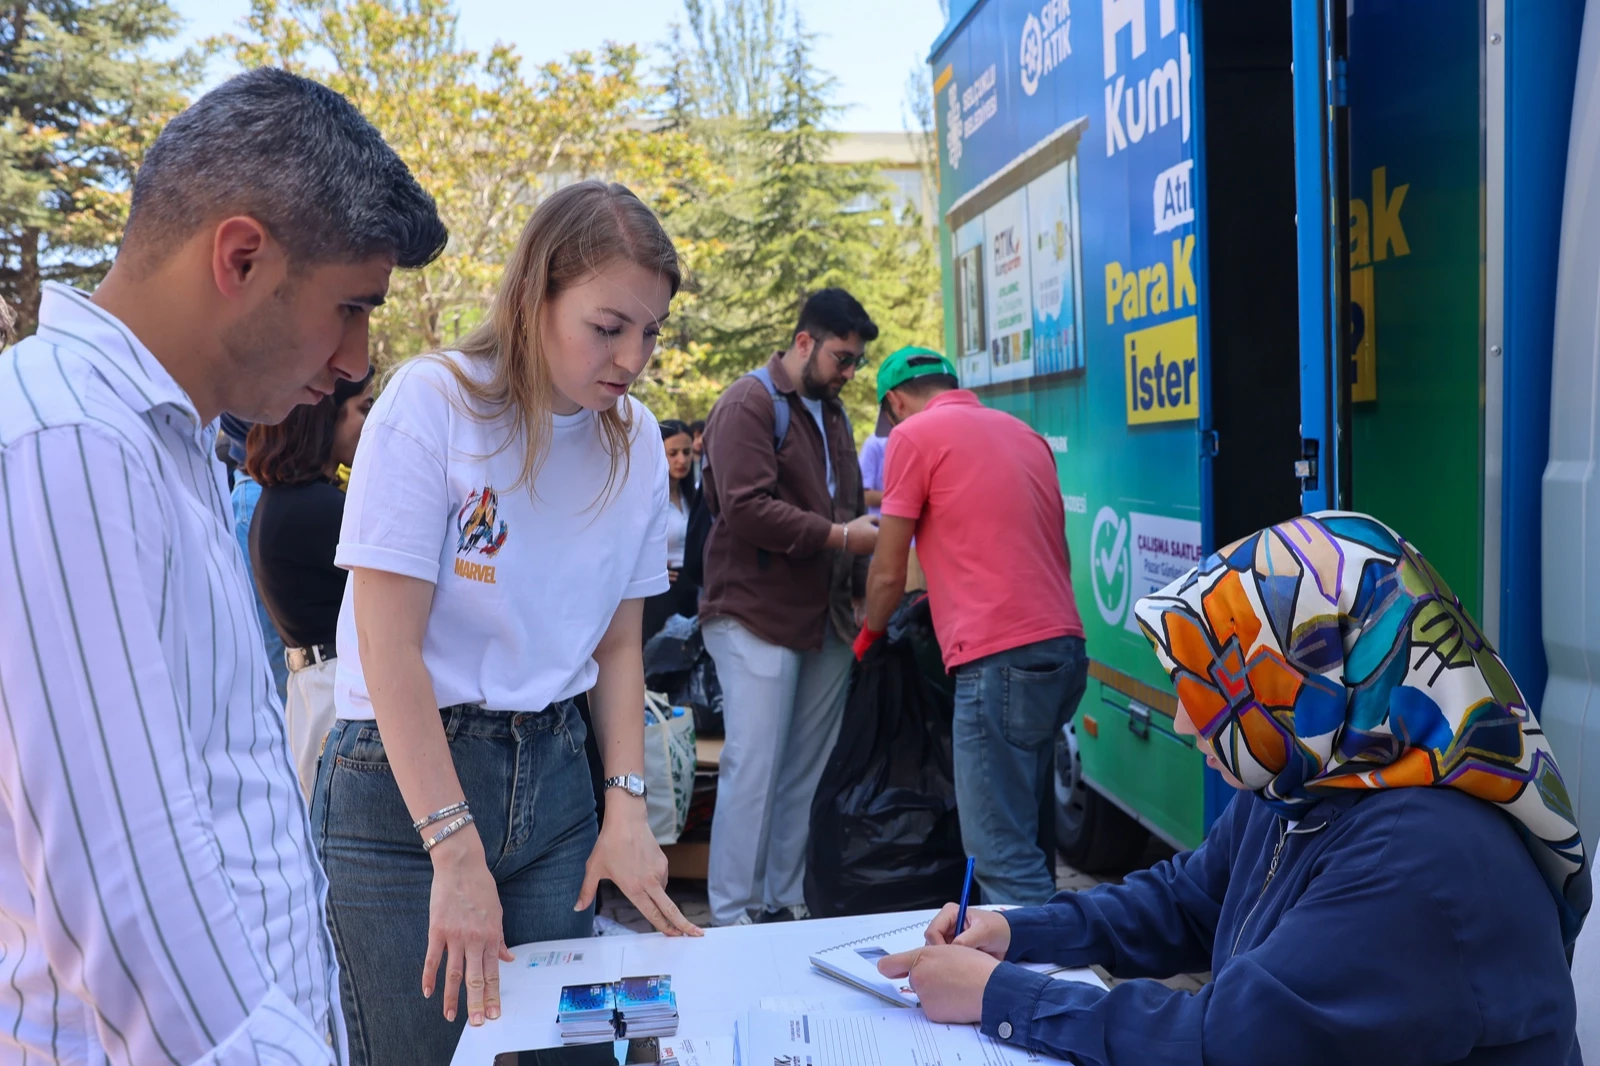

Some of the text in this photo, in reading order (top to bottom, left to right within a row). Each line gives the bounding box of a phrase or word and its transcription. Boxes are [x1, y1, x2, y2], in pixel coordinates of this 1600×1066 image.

[1043, 19, 1072, 76] ATIK
[1105, 234, 1197, 325] Para K
[1137, 534, 1169, 559] ÇALIŞMA
[454, 557, 496, 584] MARVEL
